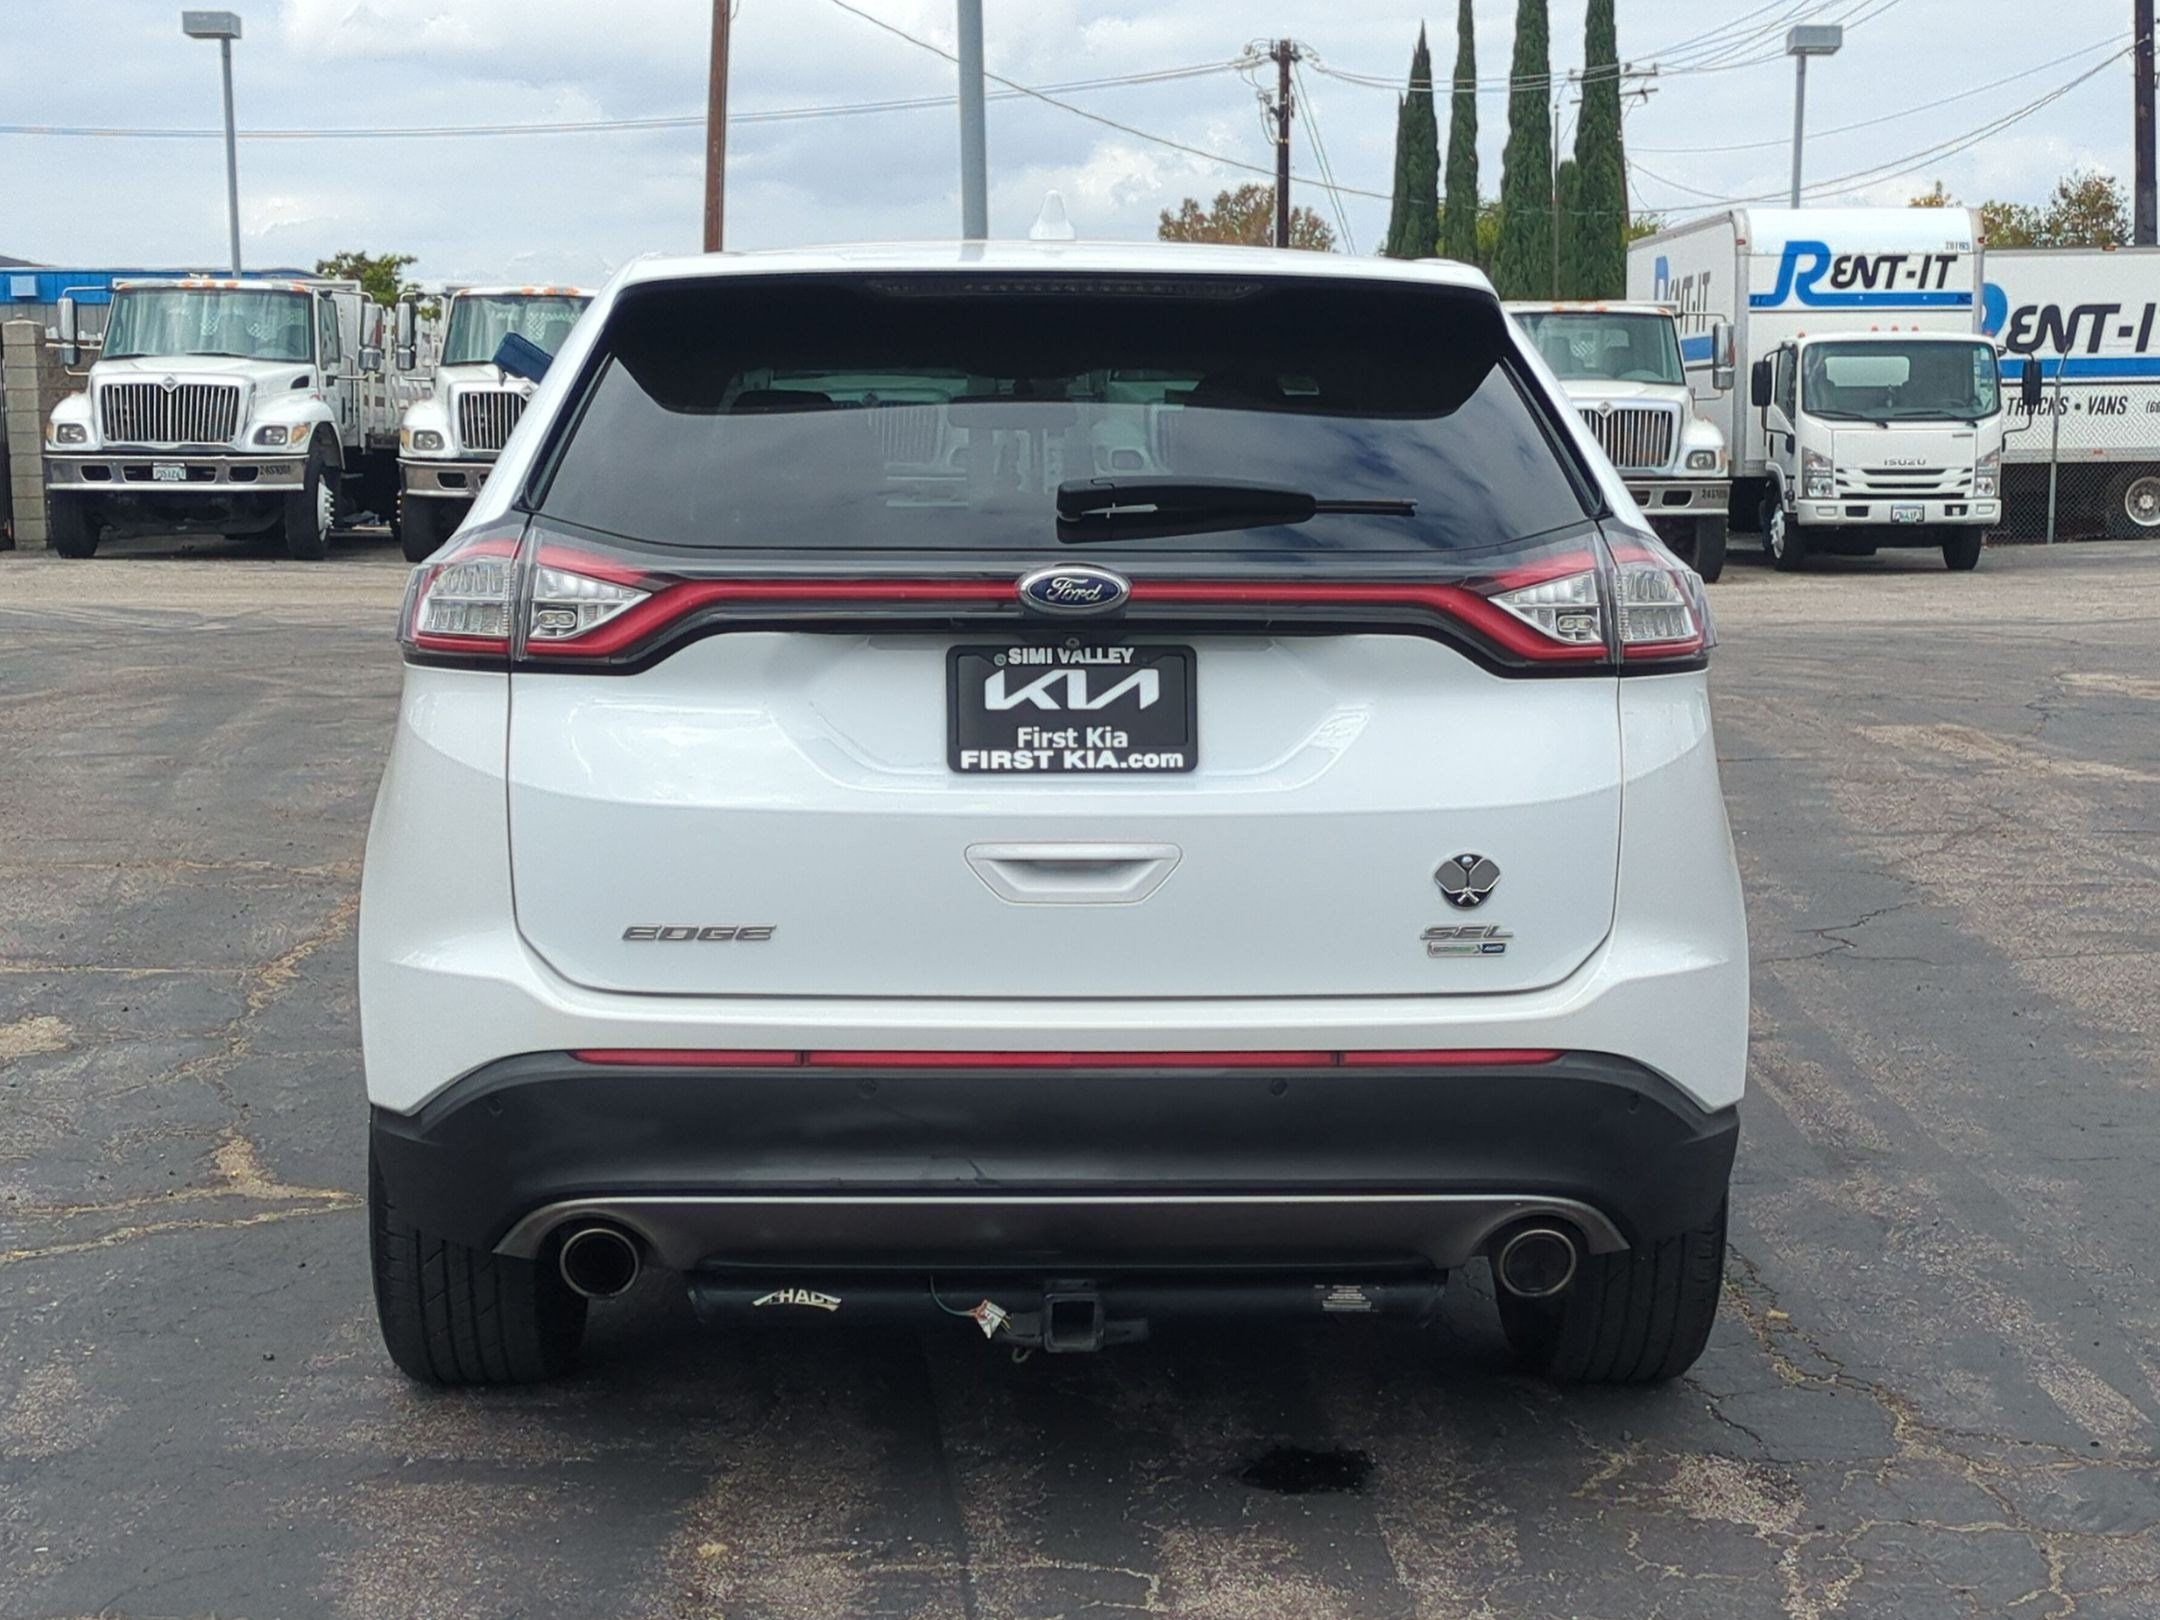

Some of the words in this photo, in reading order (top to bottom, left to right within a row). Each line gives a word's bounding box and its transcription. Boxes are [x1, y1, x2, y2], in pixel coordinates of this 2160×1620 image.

[1774, 240, 1957, 306] RENT-IT
[2088, 396, 2128, 415] VANS
[1884, 458, 1927, 466] ISUZU
[1046, 576, 1103, 601] Ford
[1008, 648, 1053, 665] SIMI
[1057, 647, 1135, 665] VALLEY
[1017, 727, 1079, 748] First
[1086, 726, 1128, 748] Kia
[960, 750, 1054, 769] FIRST
[1063, 750, 1184, 769] KIA.com
[622, 925, 777, 941] EDGE
[1420, 925, 1513, 940] SEL
